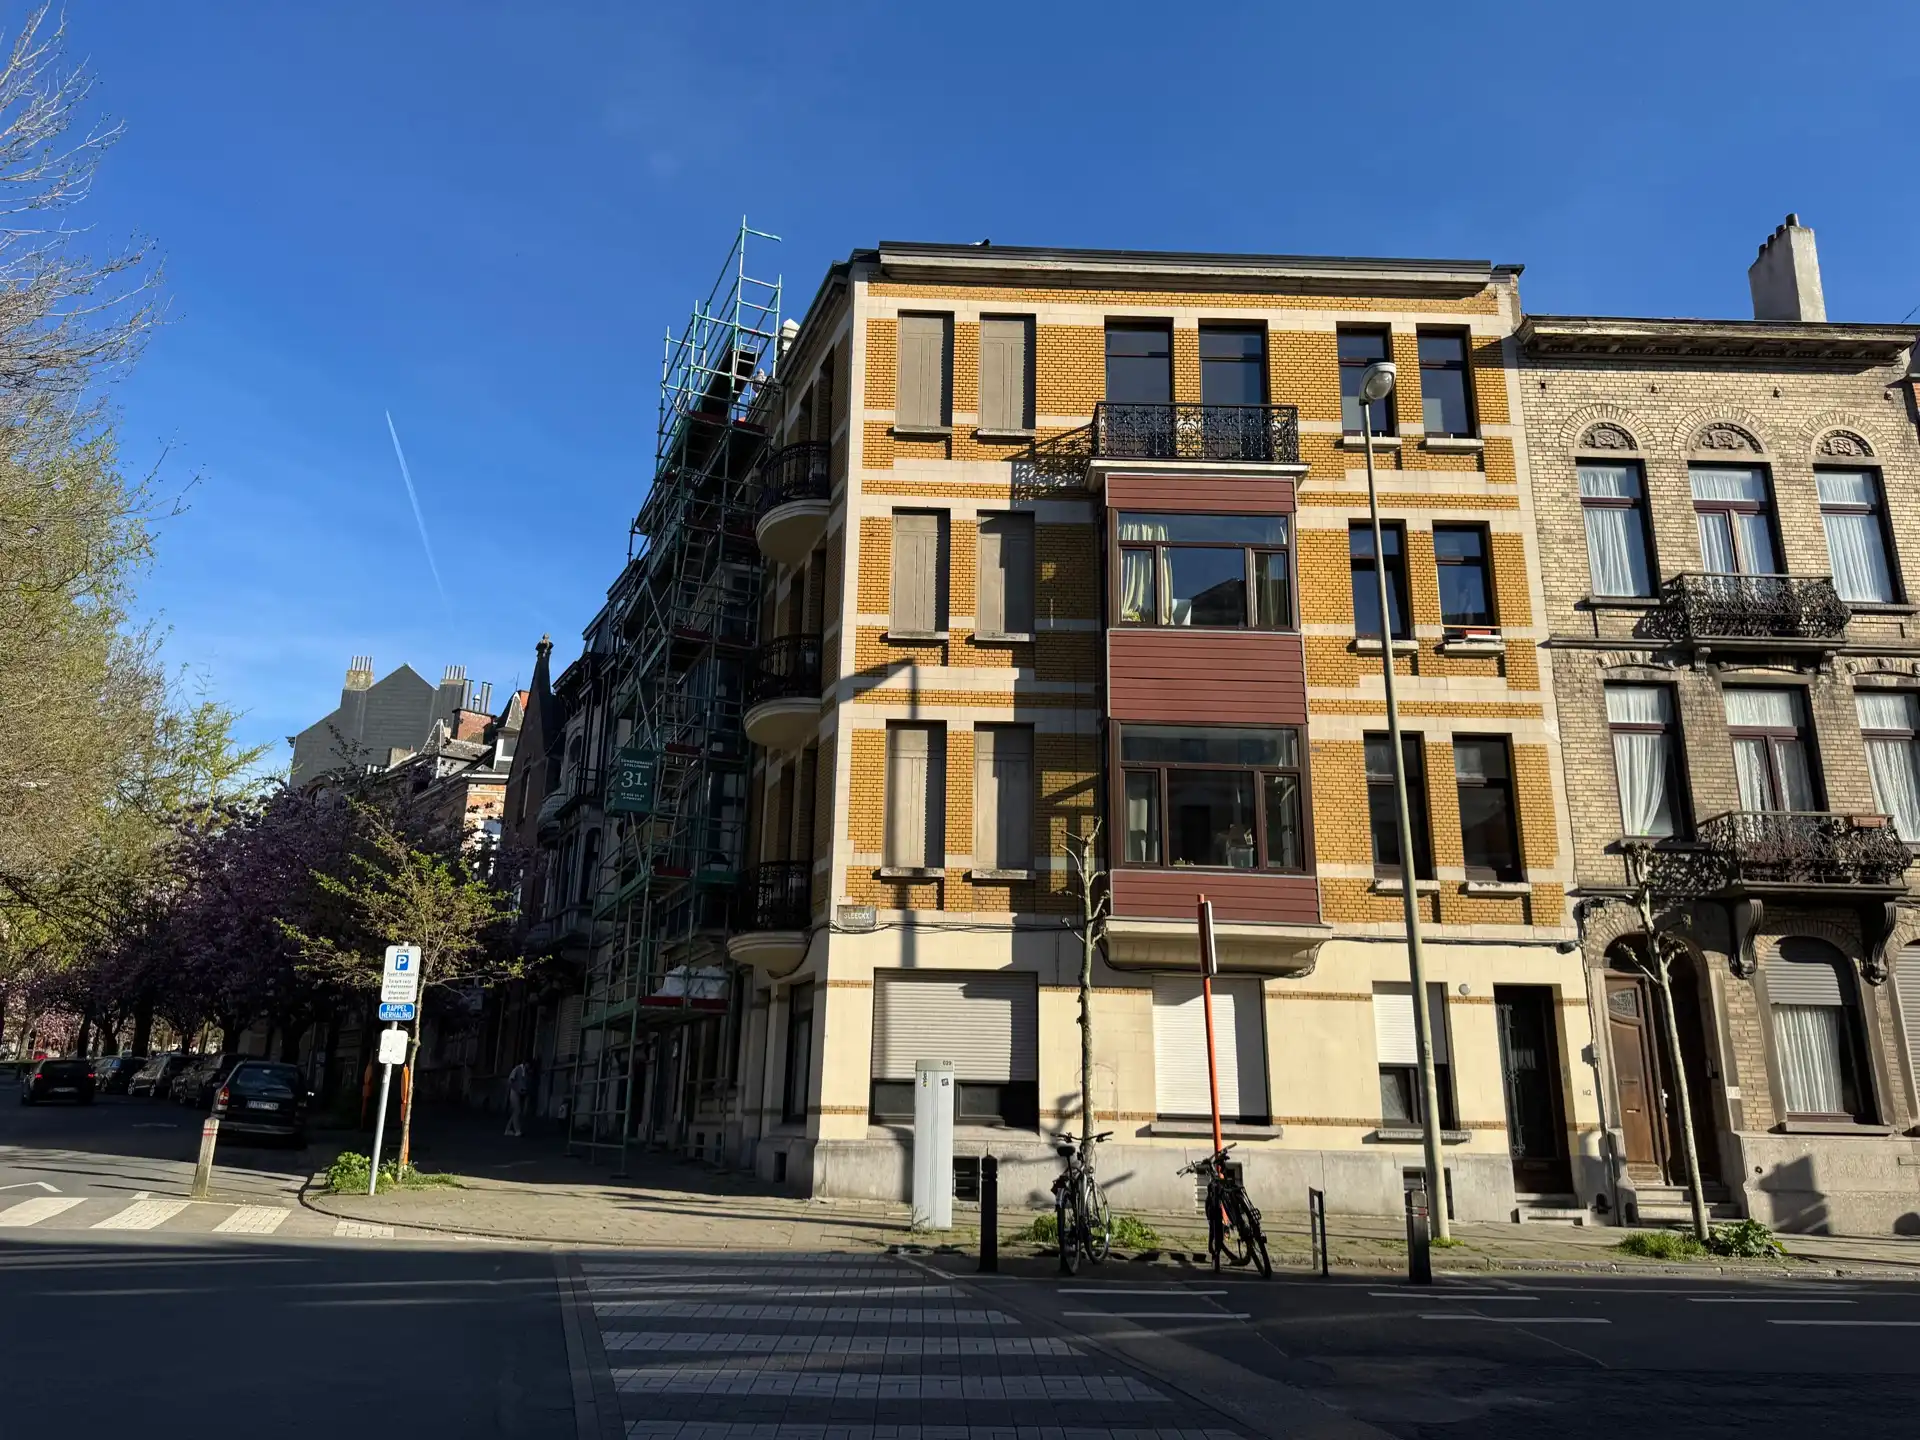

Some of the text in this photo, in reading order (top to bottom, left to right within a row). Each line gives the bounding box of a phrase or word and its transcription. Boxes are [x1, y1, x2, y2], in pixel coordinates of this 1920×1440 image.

[396, 956, 407, 969] P
[386, 1004, 407, 1012] RAPPEL
[381, 1011, 412, 1019] HERHALING
